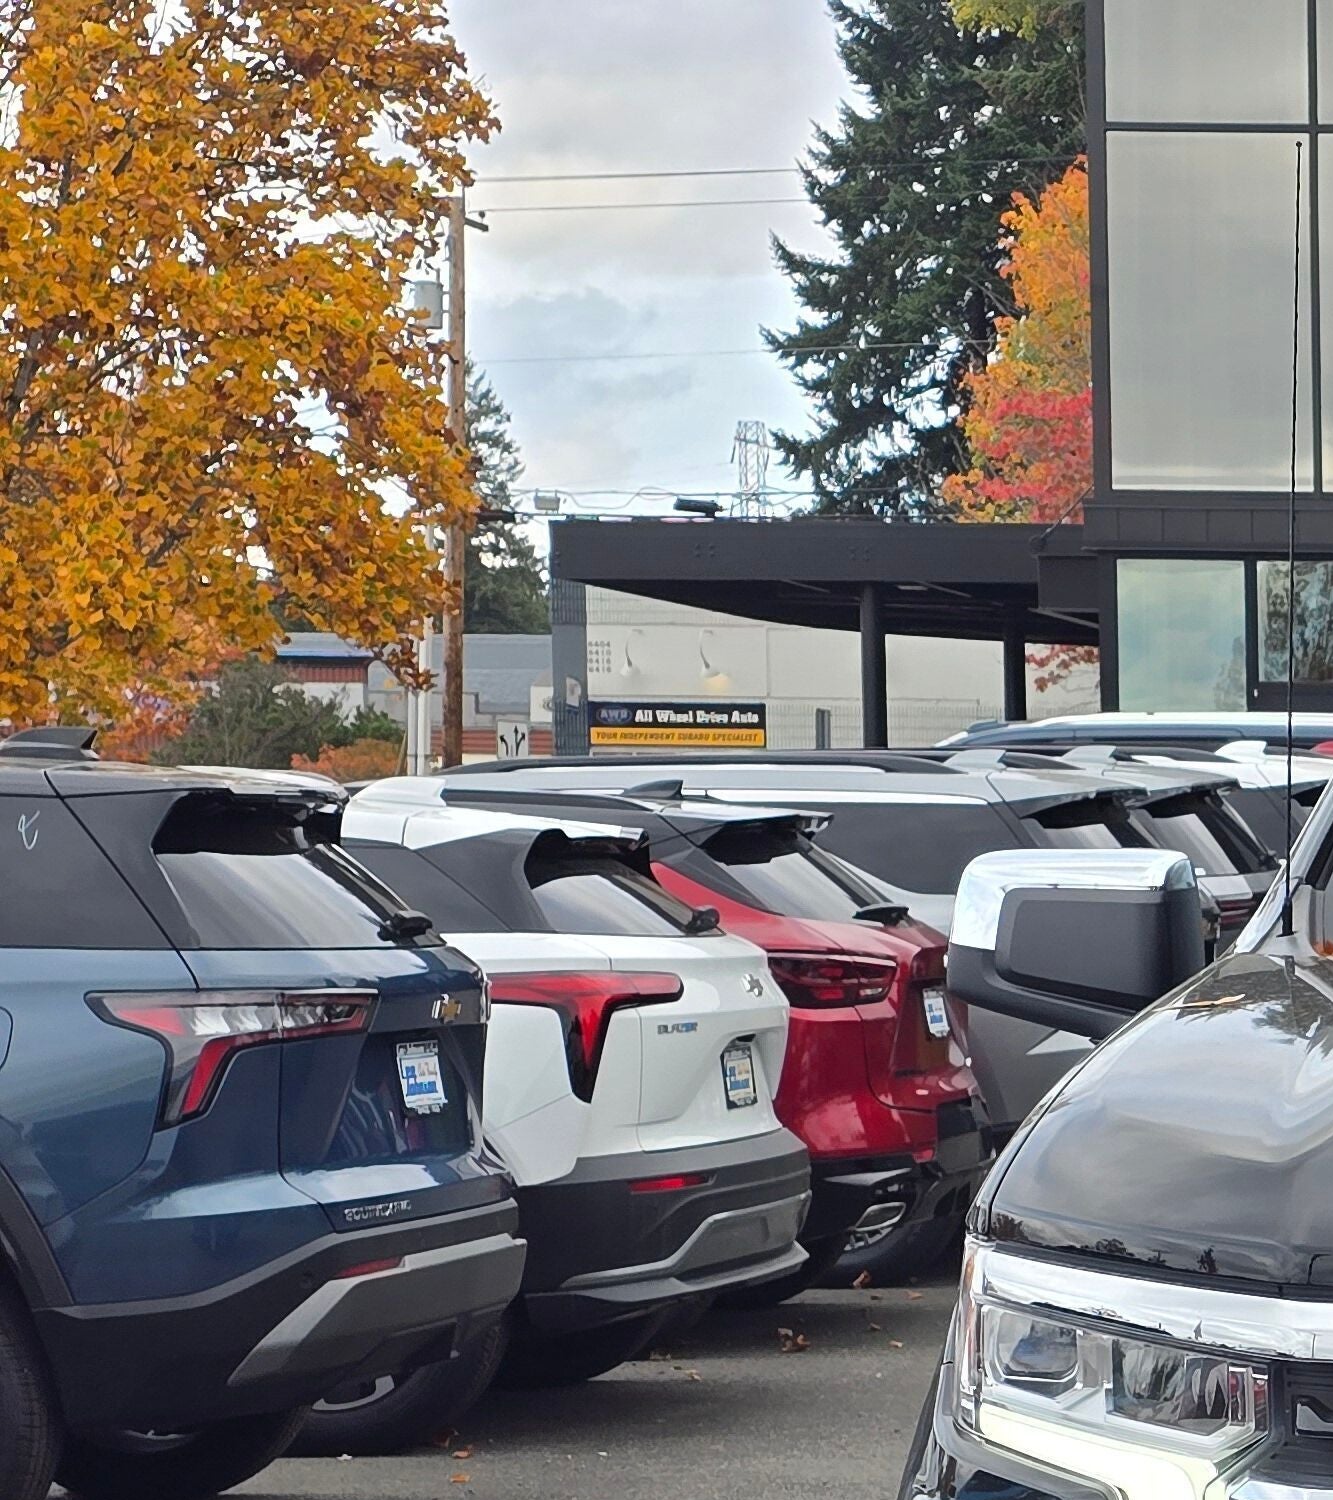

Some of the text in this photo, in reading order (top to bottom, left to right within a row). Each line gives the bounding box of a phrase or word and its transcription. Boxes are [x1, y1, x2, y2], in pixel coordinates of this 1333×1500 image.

[600, 708, 629, 722] AWD
[634, 709, 759, 723] All Wheel Drive Auto
[596, 731, 758, 742] YOUR INDEPENDENT SUBARU SPECIALIST
